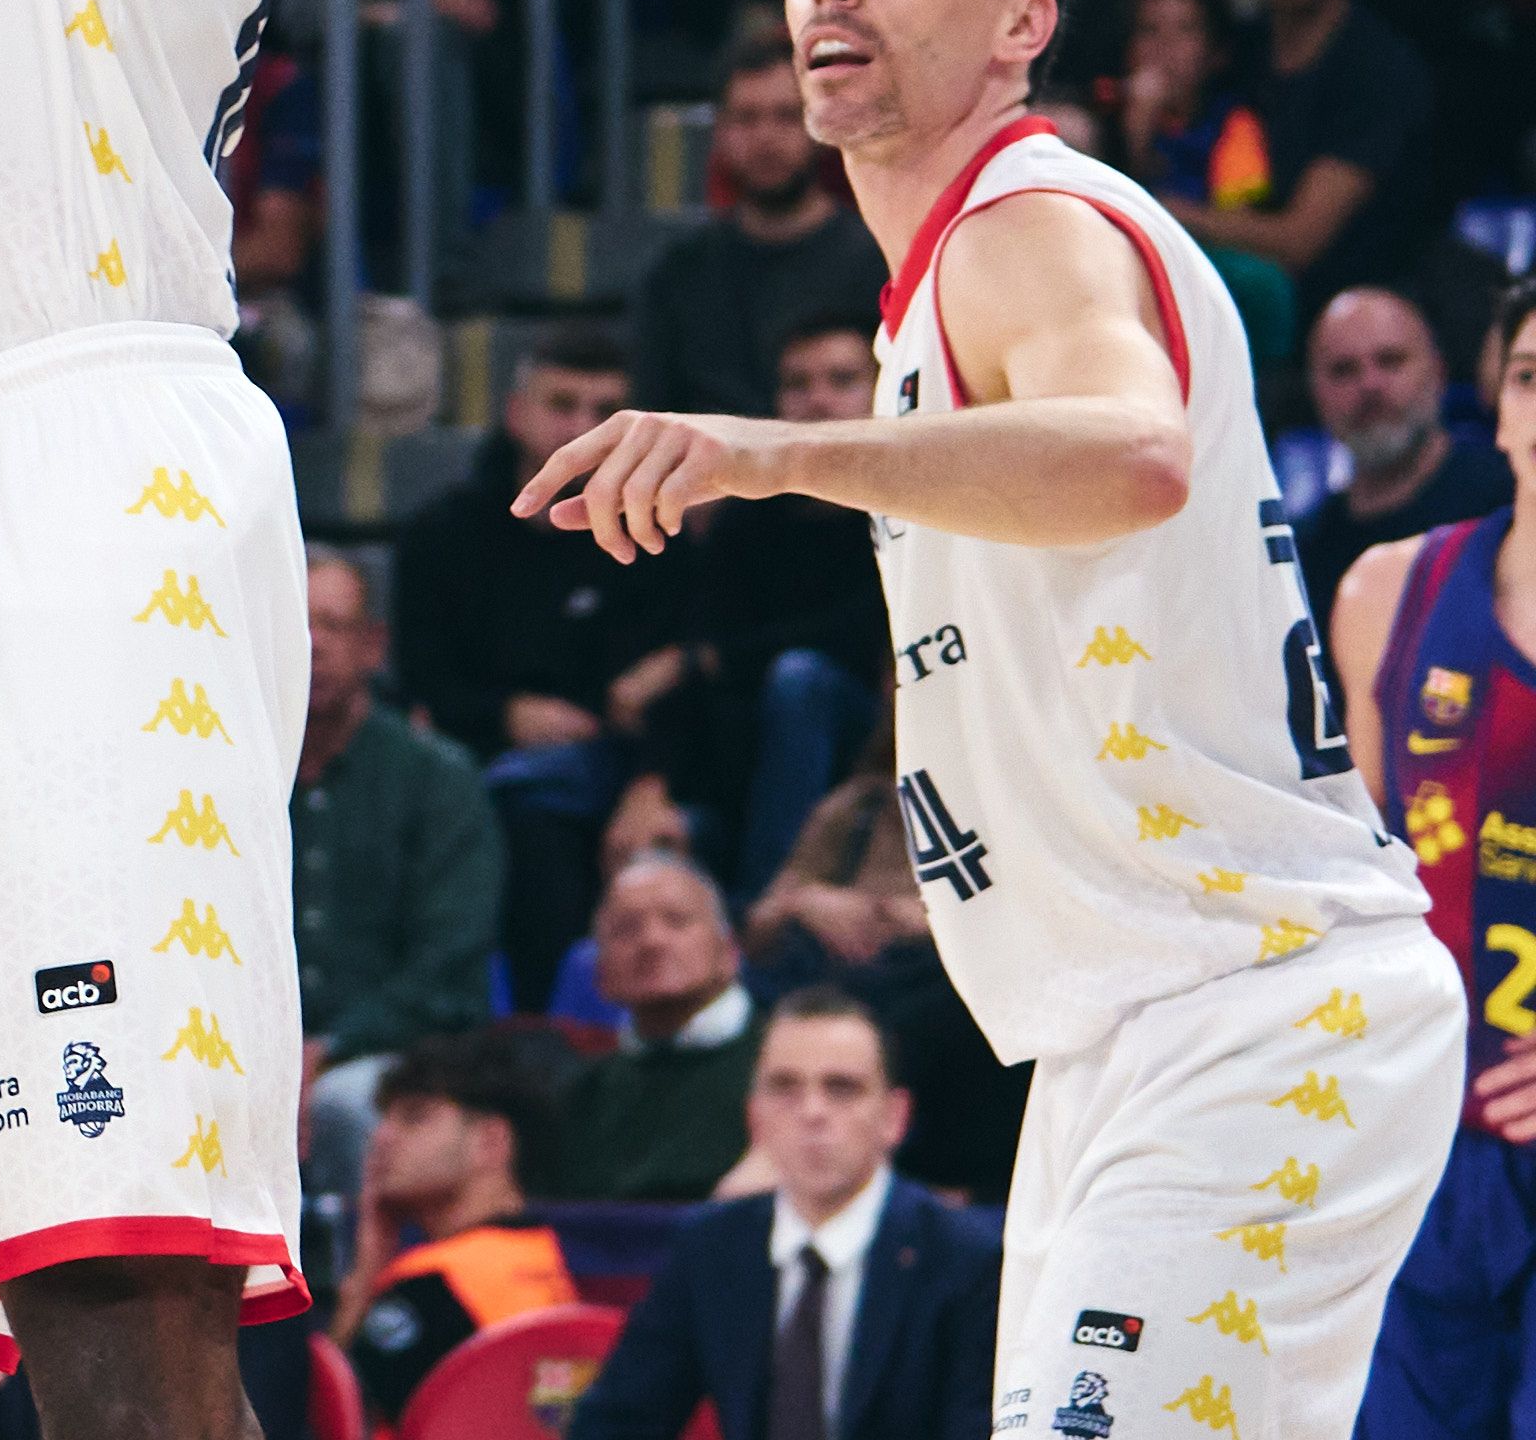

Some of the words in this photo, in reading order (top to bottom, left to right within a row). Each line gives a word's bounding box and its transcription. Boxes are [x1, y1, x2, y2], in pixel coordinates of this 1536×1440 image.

[42, 980, 100, 1010] acb
[59, 1099, 124, 1120] ANDORRA
[1075, 1324, 1126, 1347] acb
